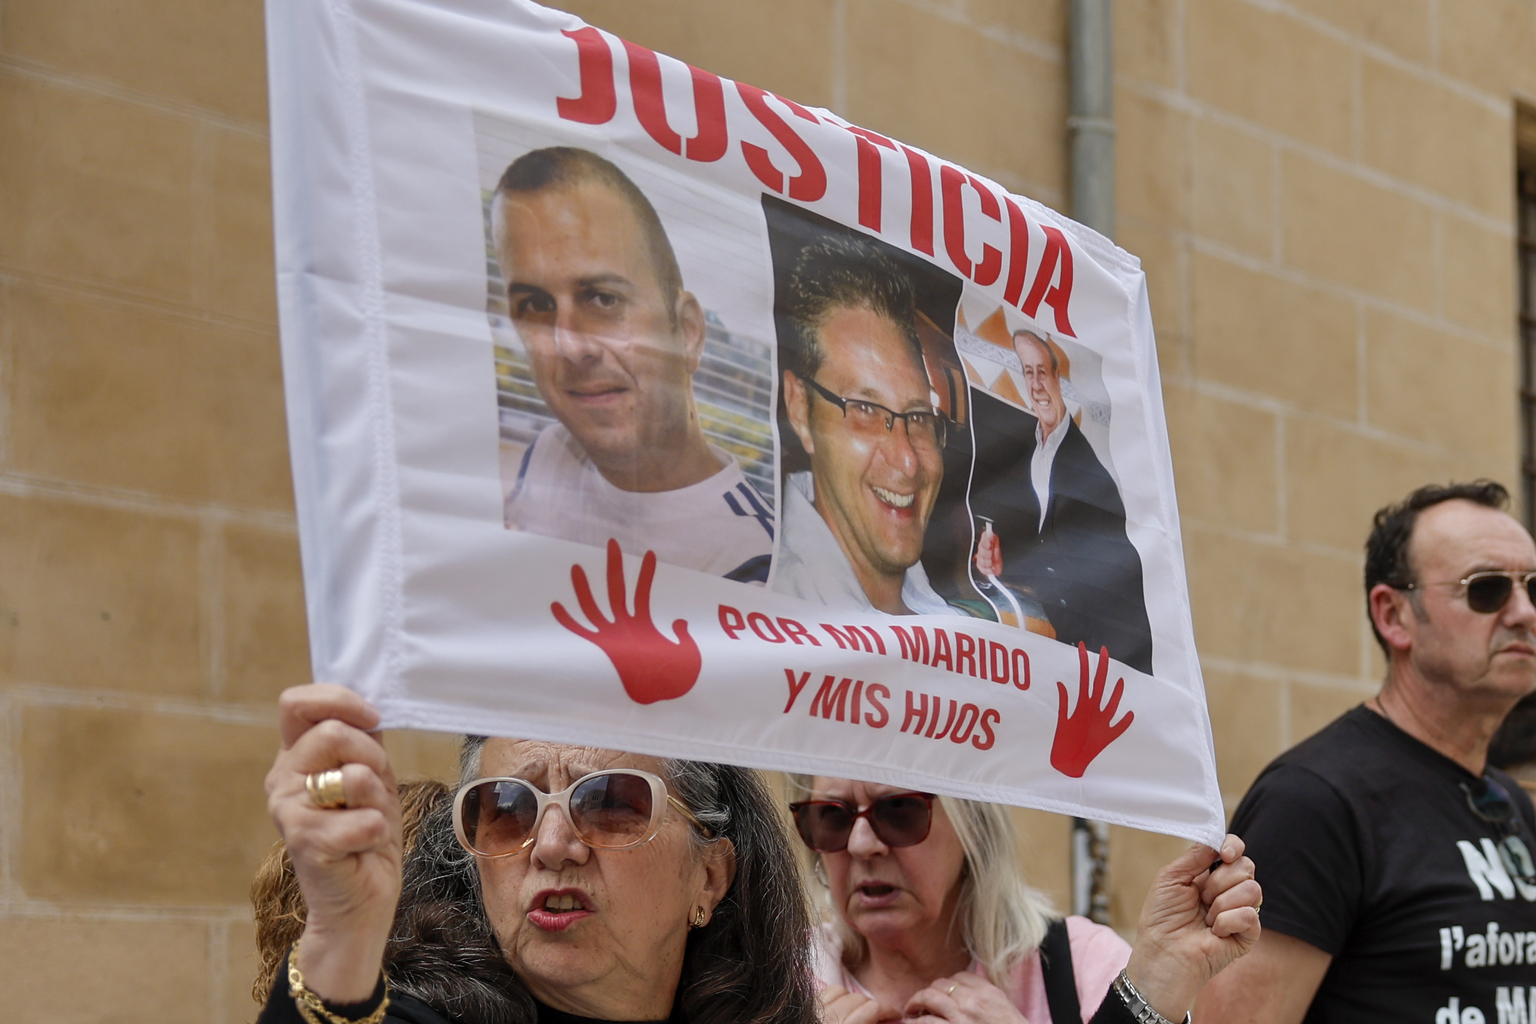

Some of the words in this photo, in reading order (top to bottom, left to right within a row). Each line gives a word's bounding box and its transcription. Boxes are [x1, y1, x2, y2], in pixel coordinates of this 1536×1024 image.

[556, 25, 1076, 338] JUSTICIA
[718, 604, 822, 647] POR
[820, 623, 887, 655] MI
[889, 625, 1031, 691] MARIDO
[783, 668, 811, 714] Y
[809, 675, 891, 729] MIS
[900, 690, 1001, 751] HIJOS
